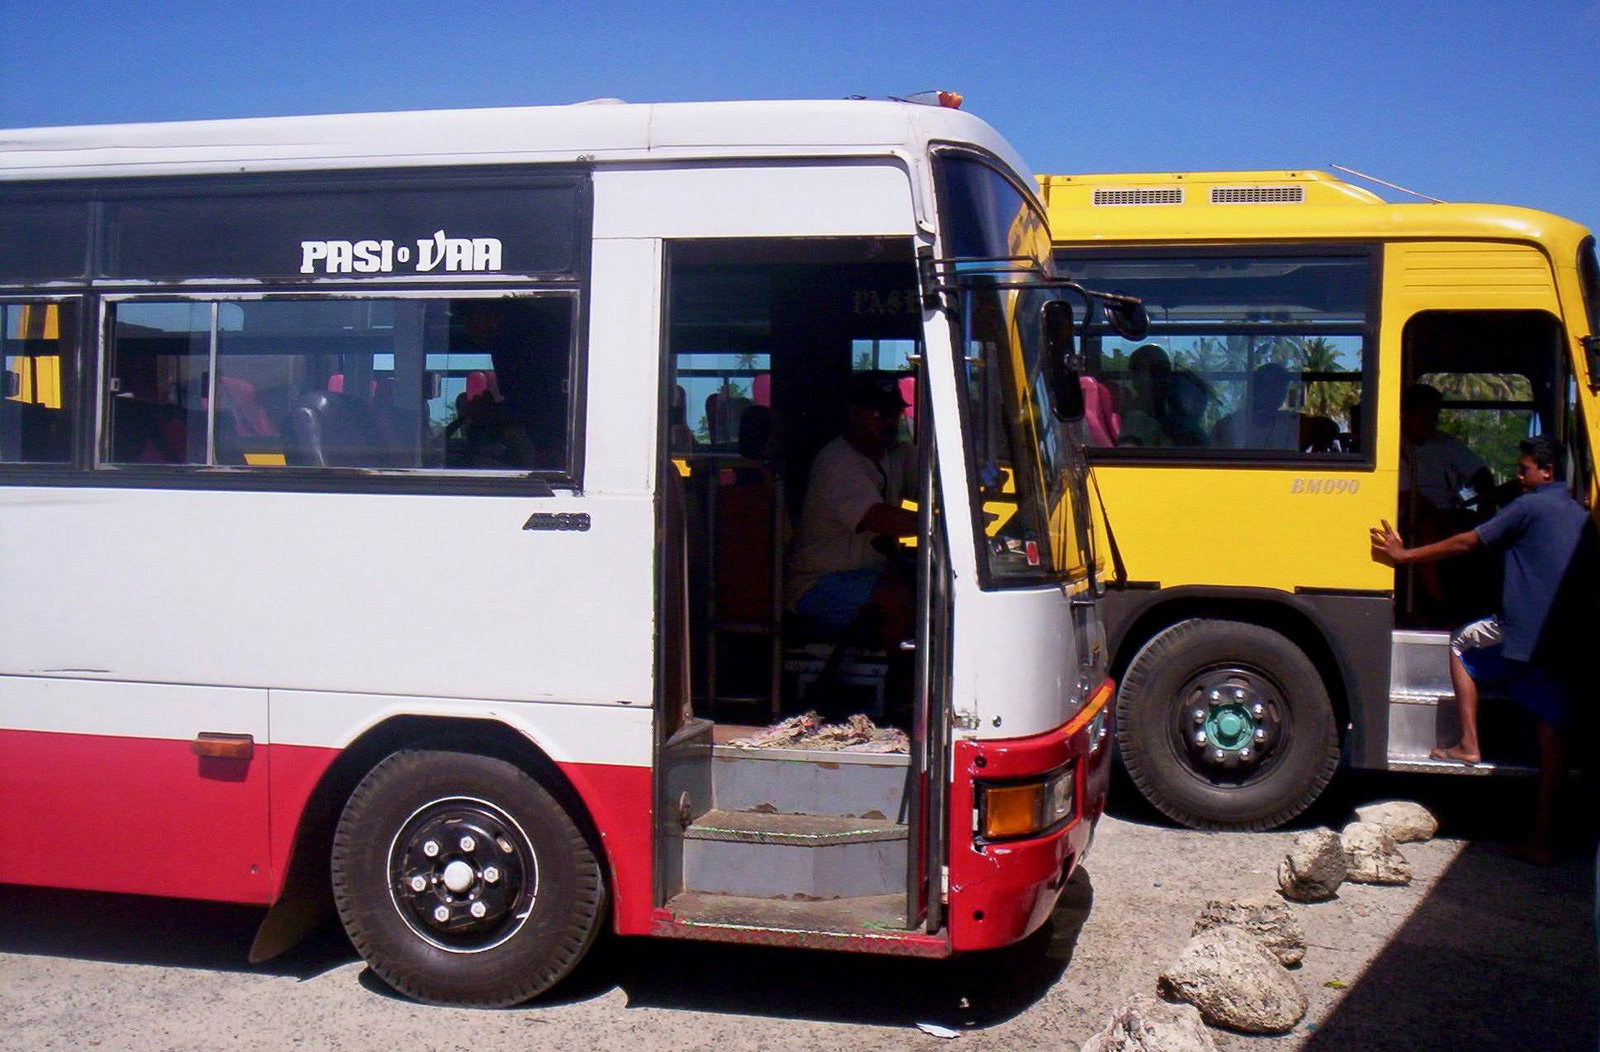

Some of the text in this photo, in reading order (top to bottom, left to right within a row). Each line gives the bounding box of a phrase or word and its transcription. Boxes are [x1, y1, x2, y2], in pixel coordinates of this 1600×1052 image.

[300, 240, 394, 273] PASI
[416, 229, 502, 271] VAA
[1290, 477, 1360, 494] BM090
